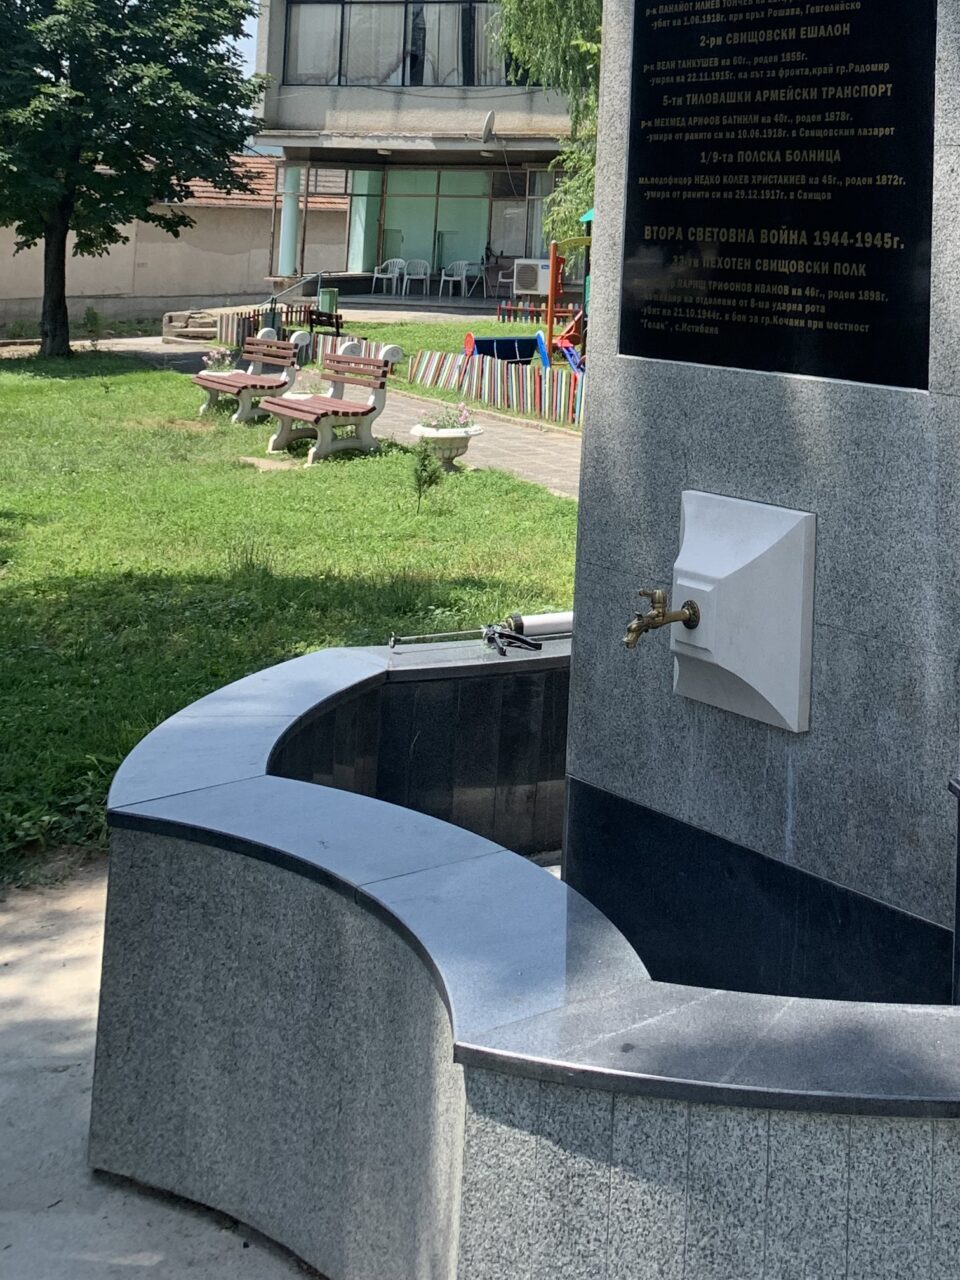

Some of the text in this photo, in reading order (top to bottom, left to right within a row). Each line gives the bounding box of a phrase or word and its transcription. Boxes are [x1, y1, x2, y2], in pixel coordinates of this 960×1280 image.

[699, 23, 850, 48] 2-ри СВИЩОВСКИ ЕШАЛОН
[662, 84, 892, 105] 5-ти ТИЛОВАШКИ АРМЕЙСКИ ТРАНСПОРТ
[700, 150, 841, 163] 1/9-та ПОЛСКА БОЛНИЦА
[644, 225, 904, 248] ВТОРА СВЕТОВНА ВОЙНА 1944-1945г.
[702, 255, 750, 269] ПЕХОТЕН
[755, 258, 829, 275] СВИЩОВСКИ
[833, 262, 866, 275] ПОЛК
